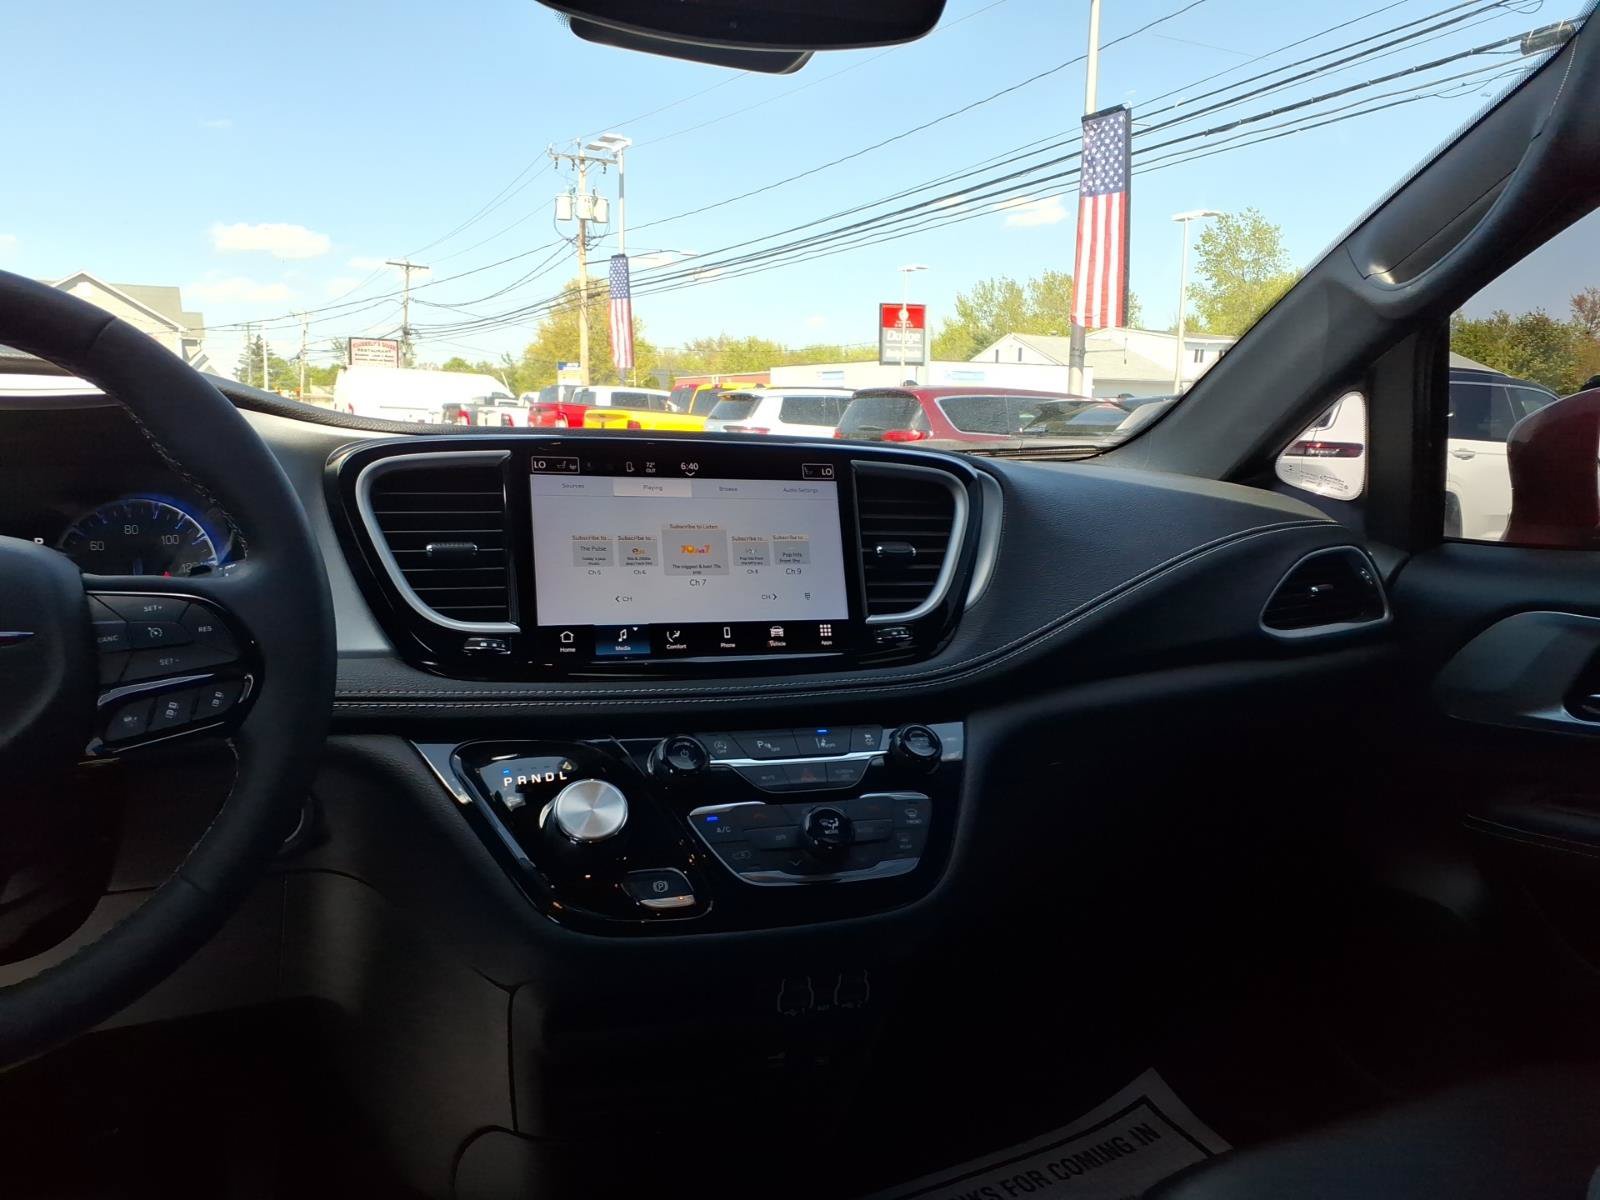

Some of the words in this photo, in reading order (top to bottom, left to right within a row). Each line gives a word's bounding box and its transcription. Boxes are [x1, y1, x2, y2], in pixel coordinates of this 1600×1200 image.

[534, 460, 546, 469] LO
[680, 462, 699, 471] 6:40
[821, 468, 832, 476] LO
[643, 484, 664, 492] Playing
[124, 525, 139, 535] 80
[161, 534, 180, 545] 100
[89, 540, 105, 551] 60
[785, 567, 796, 575] Ch
[689, 578, 701, 587] Ch
[701, 578, 707, 586] 7
[198, 625, 213, 633] RES
[503, 777, 513, 787] P
[517, 775, 527, 785] R
[531, 773, 542, 784] N
[545, 772, 555, 782] D
[559, 770, 568, 781] L
[1000, 1169, 1053, 1198] FOR
[1047, 1136, 1134, 1181] COMING
[1131, 1122, 1162, 1149] IN
